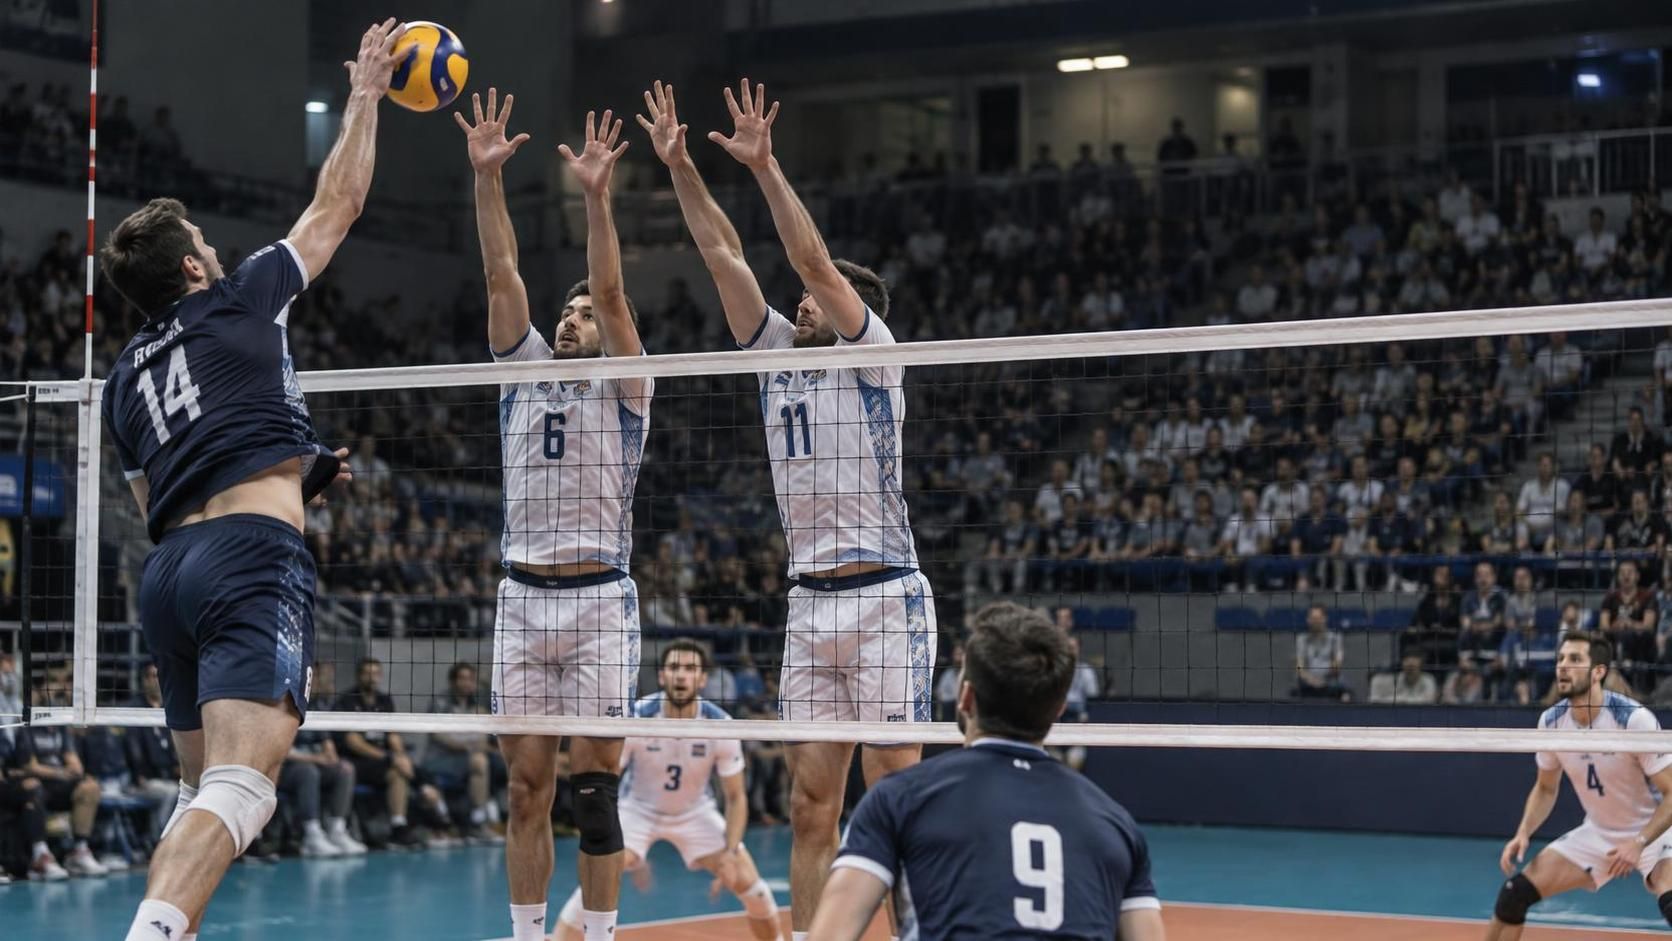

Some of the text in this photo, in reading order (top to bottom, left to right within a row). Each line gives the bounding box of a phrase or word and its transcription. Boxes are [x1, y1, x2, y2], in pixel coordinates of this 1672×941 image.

[137, 344, 201, 445] 14
[543, 412, 566, 460] 6
[781, 402, 811, 457] 11
[664, 764, 682, 791] 3
[1587, 763, 1605, 796] 4
[1011, 821, 1064, 931] 9
